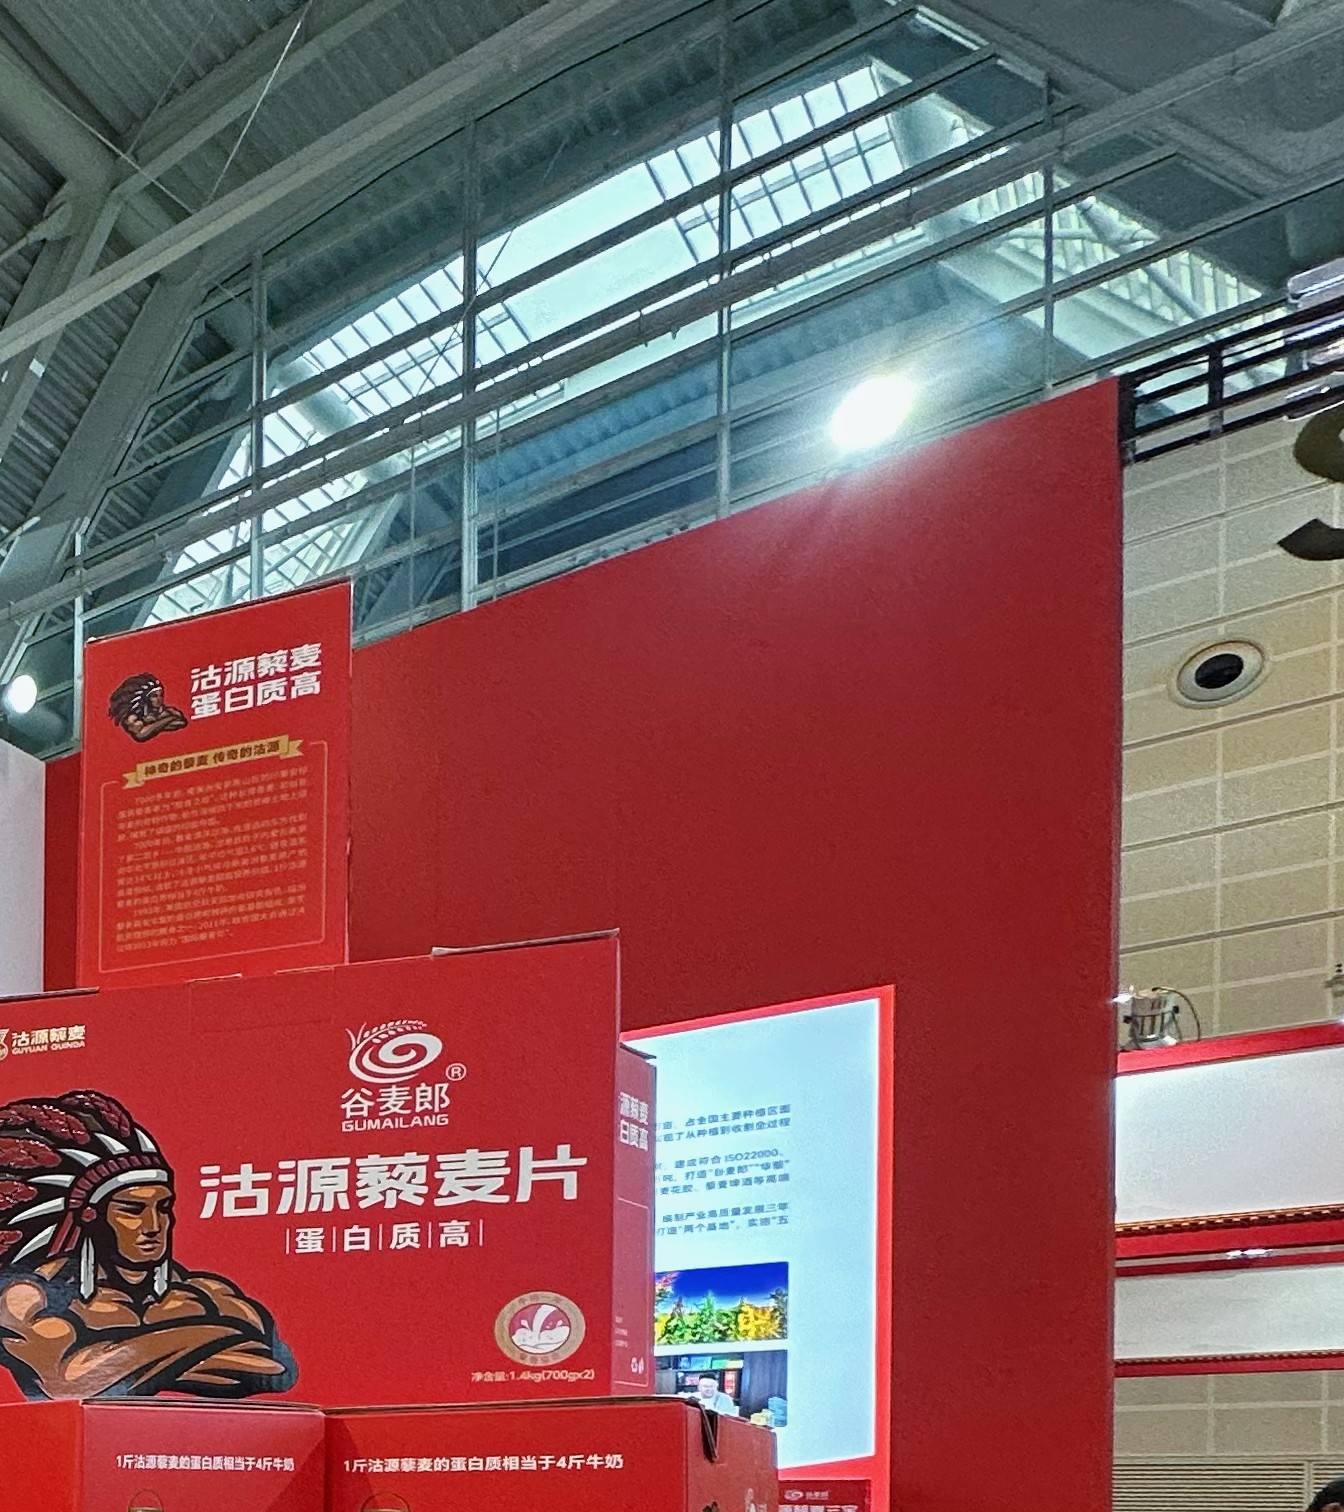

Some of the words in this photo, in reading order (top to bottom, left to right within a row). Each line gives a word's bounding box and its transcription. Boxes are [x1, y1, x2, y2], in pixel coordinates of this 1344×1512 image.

[191, 642, 321, 693] 沽源藜麦
[191, 671, 321, 720] 蛋白质高
[340, 1082, 449, 1118] 谷麦郎
[341, 1113, 449, 1133] GUMAILANG
[199, 1144, 587, 1219] 沽源藜麦片
[116, 1454, 295, 1473] 1斤沽源藜麦的蛋白质相当于4斤牛奶
[344, 1454, 624, 1474] 1斤沽源藜麦的蛋白质相当于4斤牛奶
